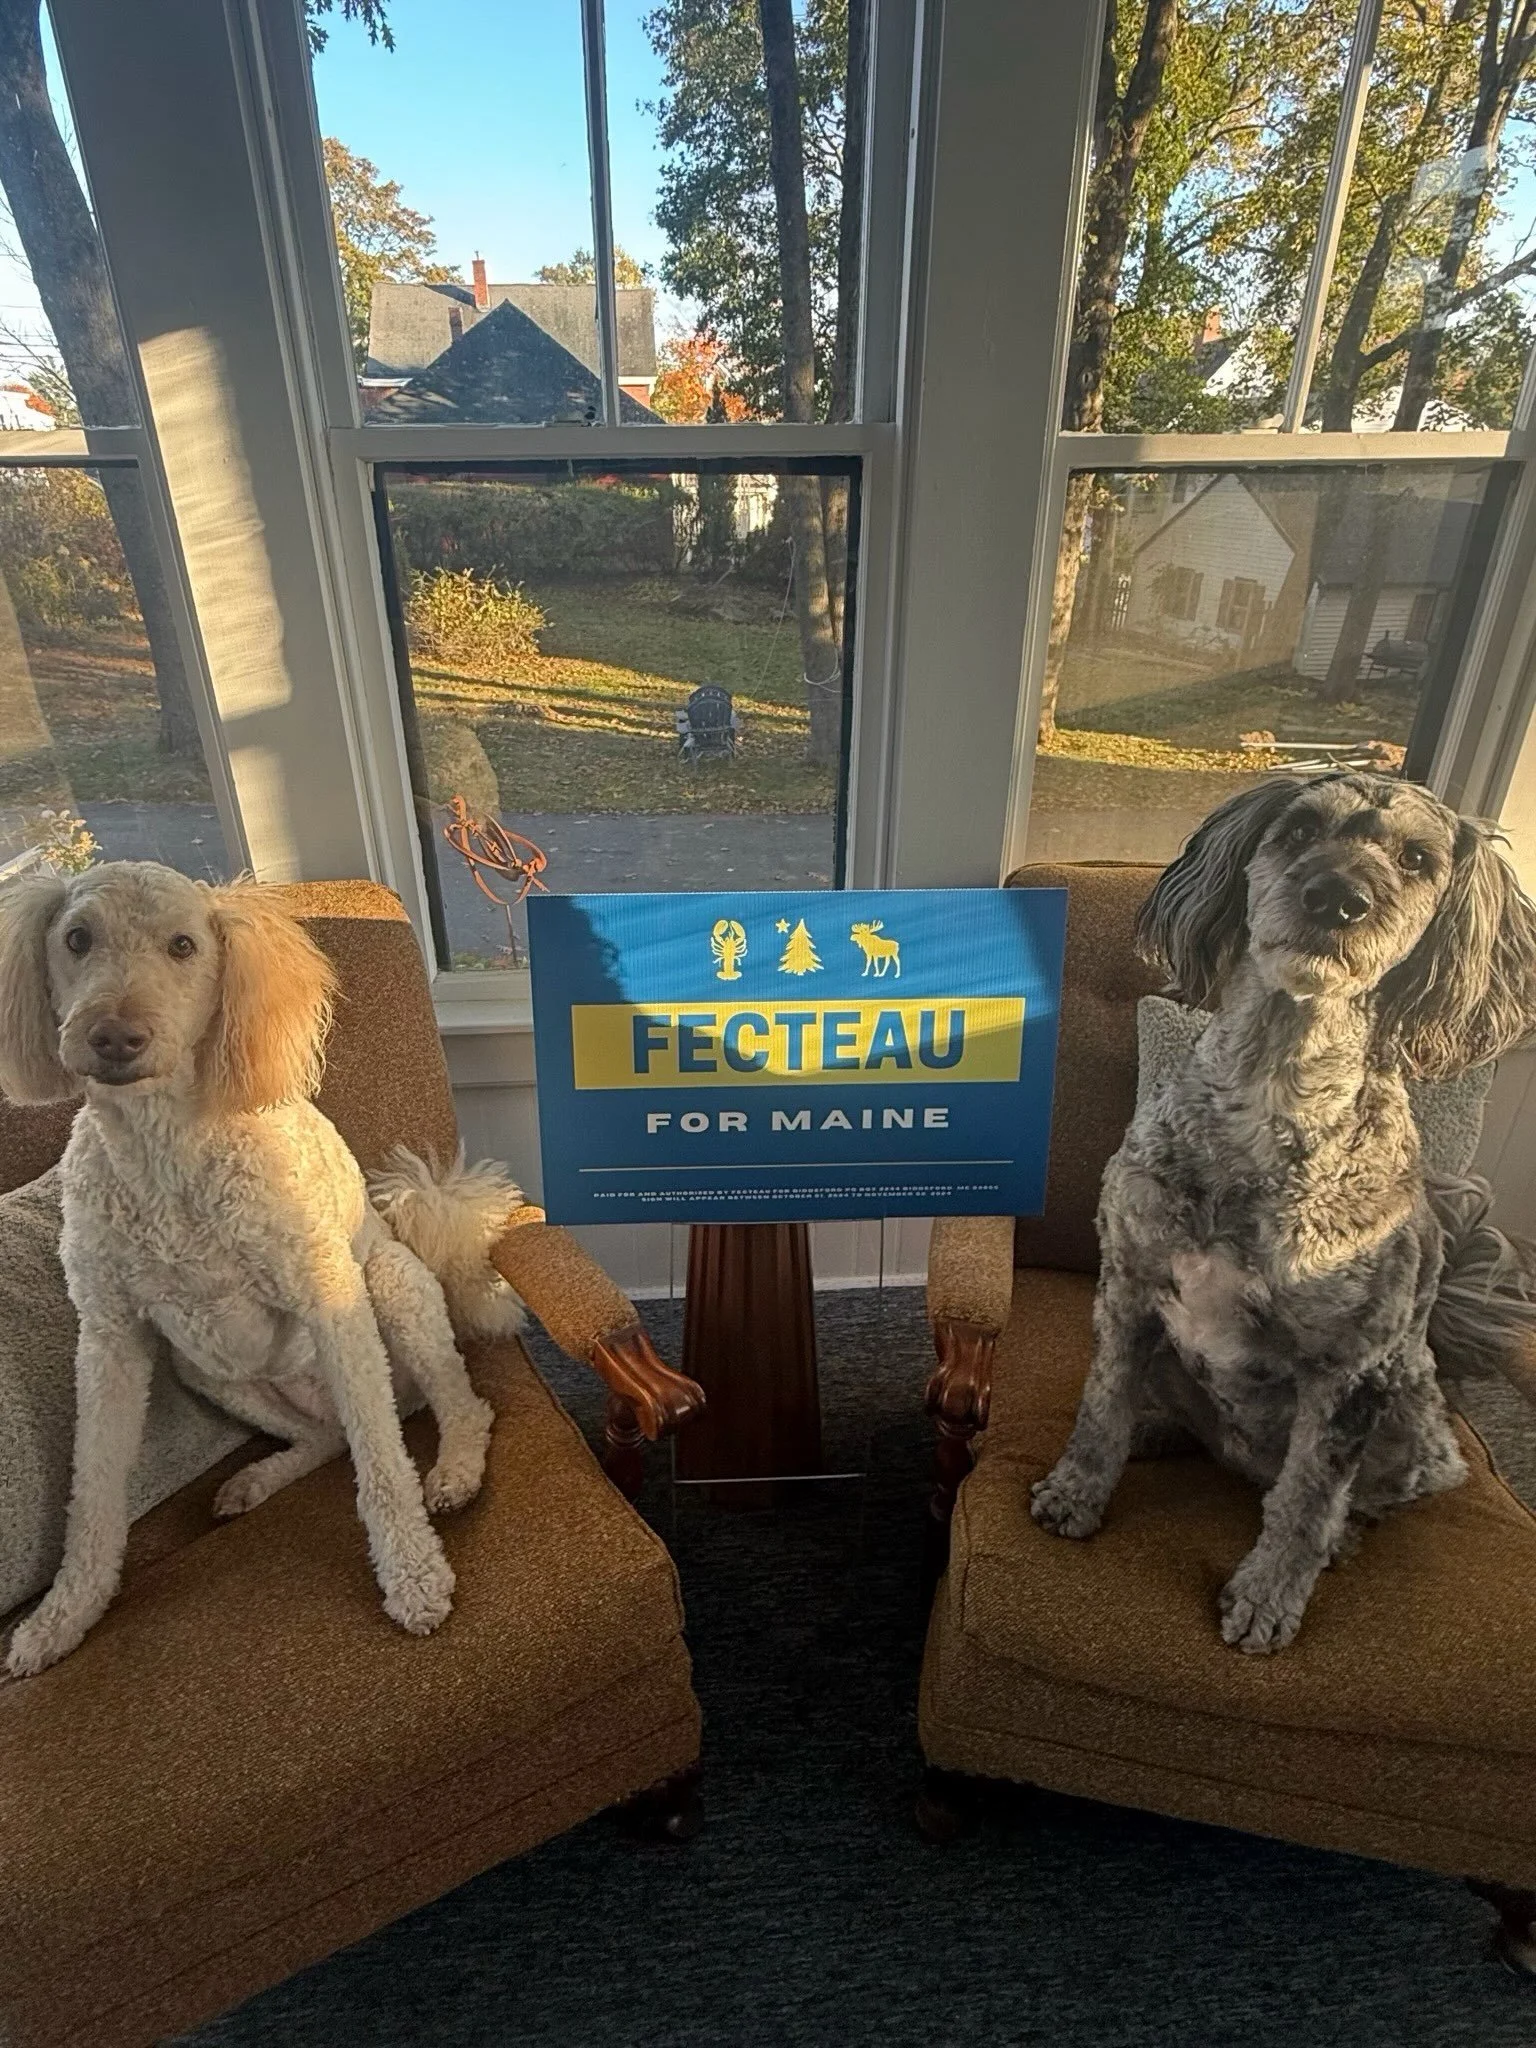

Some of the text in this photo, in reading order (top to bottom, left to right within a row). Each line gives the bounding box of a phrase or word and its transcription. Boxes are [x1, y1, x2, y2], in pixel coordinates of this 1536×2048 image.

[632, 1010, 966, 1074] FECTEAU
[647, 1107, 950, 1134] FOR MAINE
